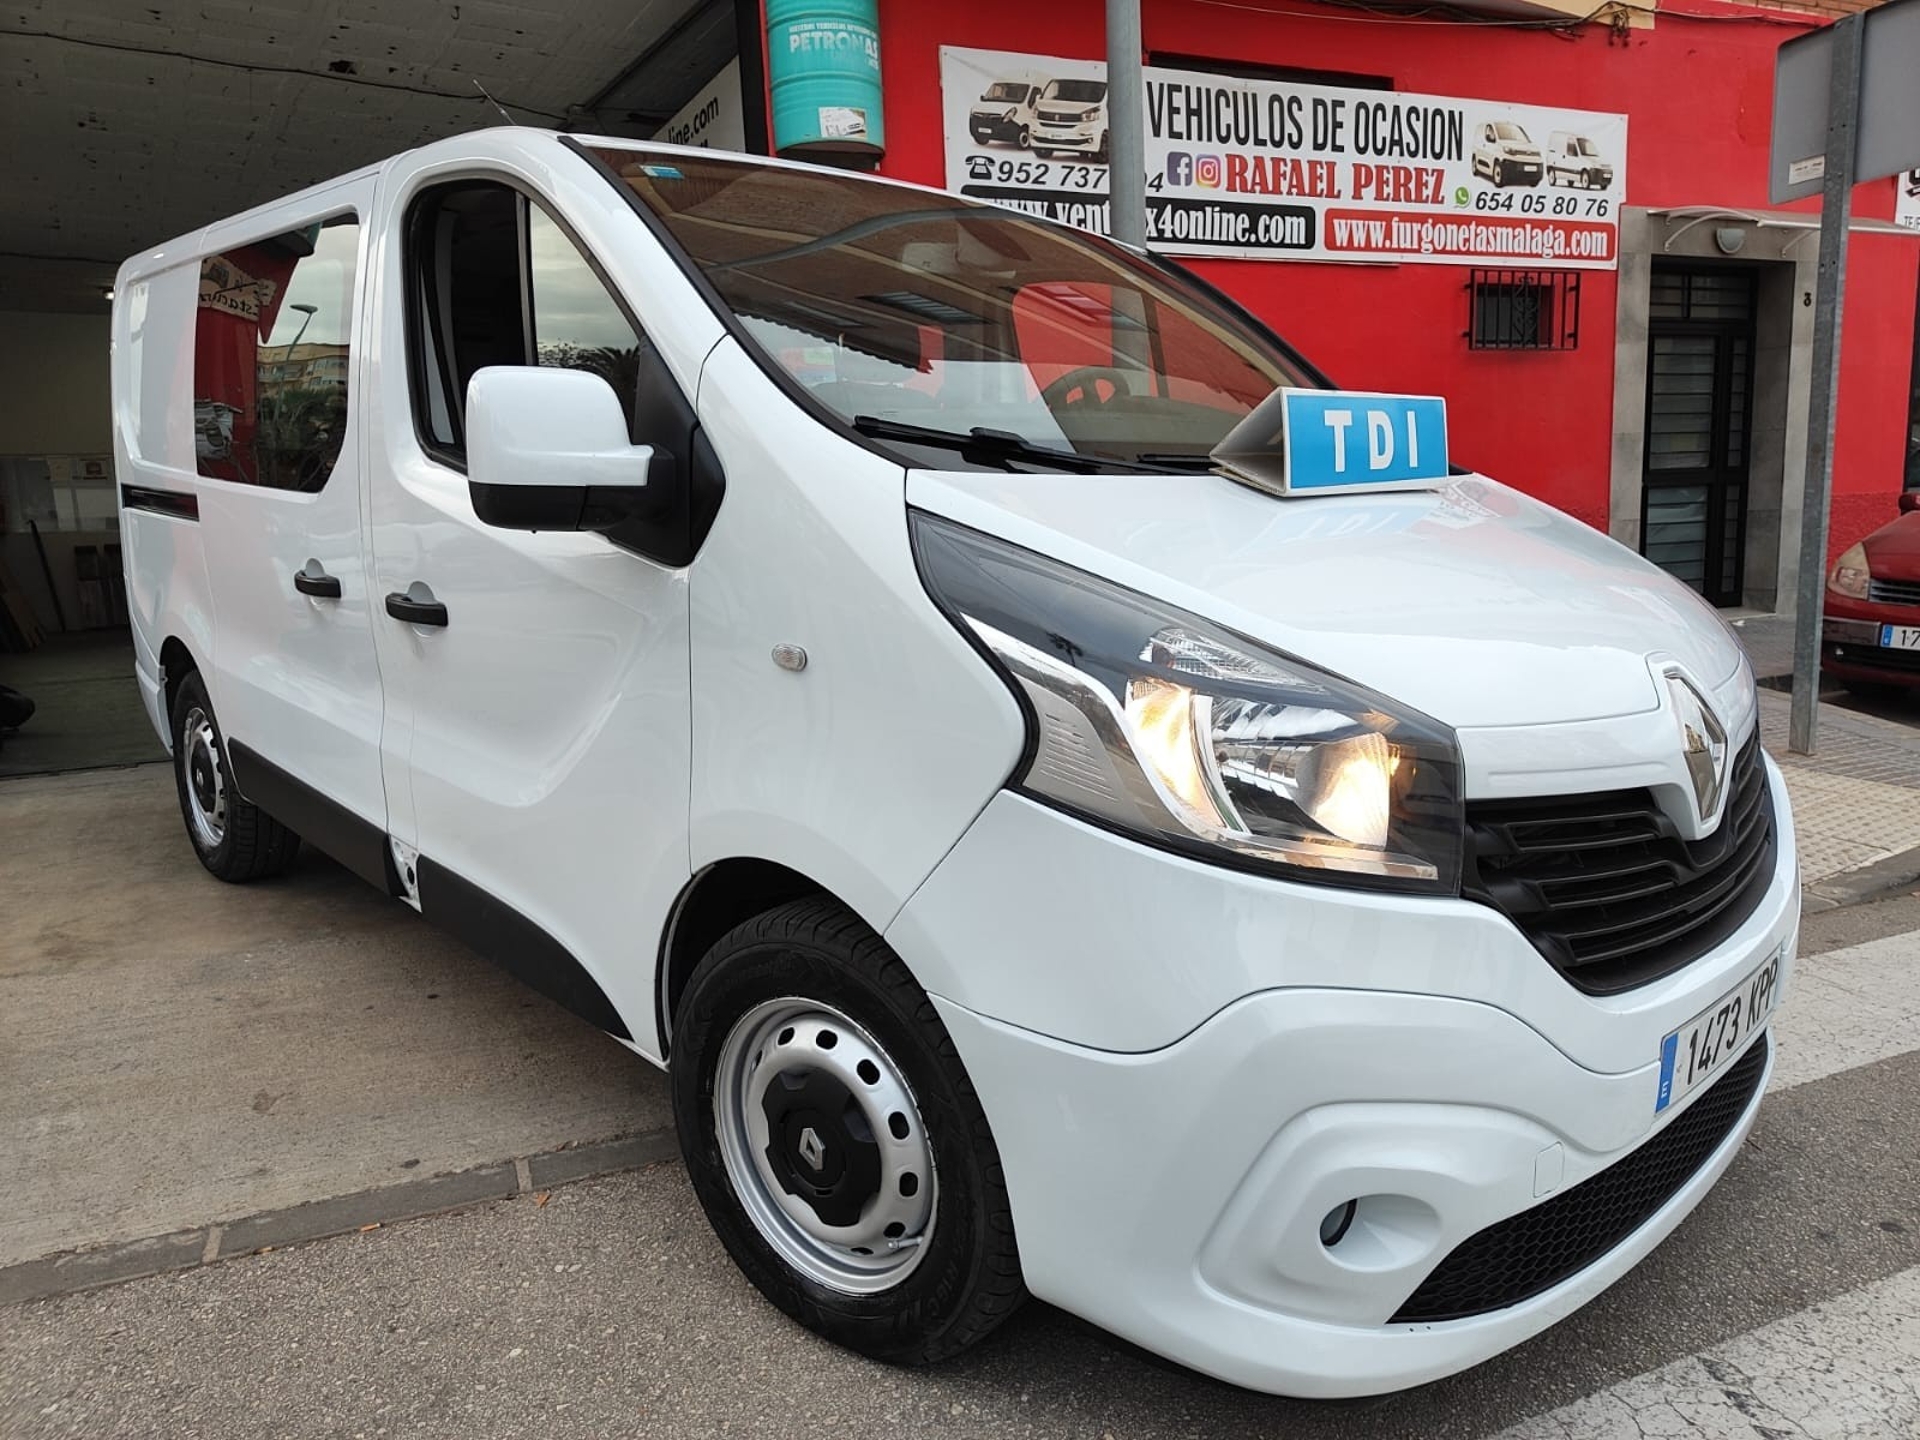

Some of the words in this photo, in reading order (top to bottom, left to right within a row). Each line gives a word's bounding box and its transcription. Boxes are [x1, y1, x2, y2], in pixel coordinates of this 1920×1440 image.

[1146, 81, 1303, 150] VEHICULOS
[1312, 97, 1346, 153] DE
[1354, 101, 1464, 161] OCASION
[997, 160, 1049, 186] 952
[1060, 165, 1108, 189] 737
[1225, 153, 1341, 199] RAFAEL
[1351, 163, 1446, 205] PEREZ
[1475, 191, 1514, 212] 654
[1520, 194, 1545, 214] 05
[1552, 196, 1578, 216] 80
[1584, 198, 1609, 217] 76
[1332, 216, 1609, 259] www.furgonetasmalaga.com
[1324, 410, 1419, 473] TDI
[1687, 996, 1742, 1085] 1473
[1746, 956, 1779, 1032] KPP
